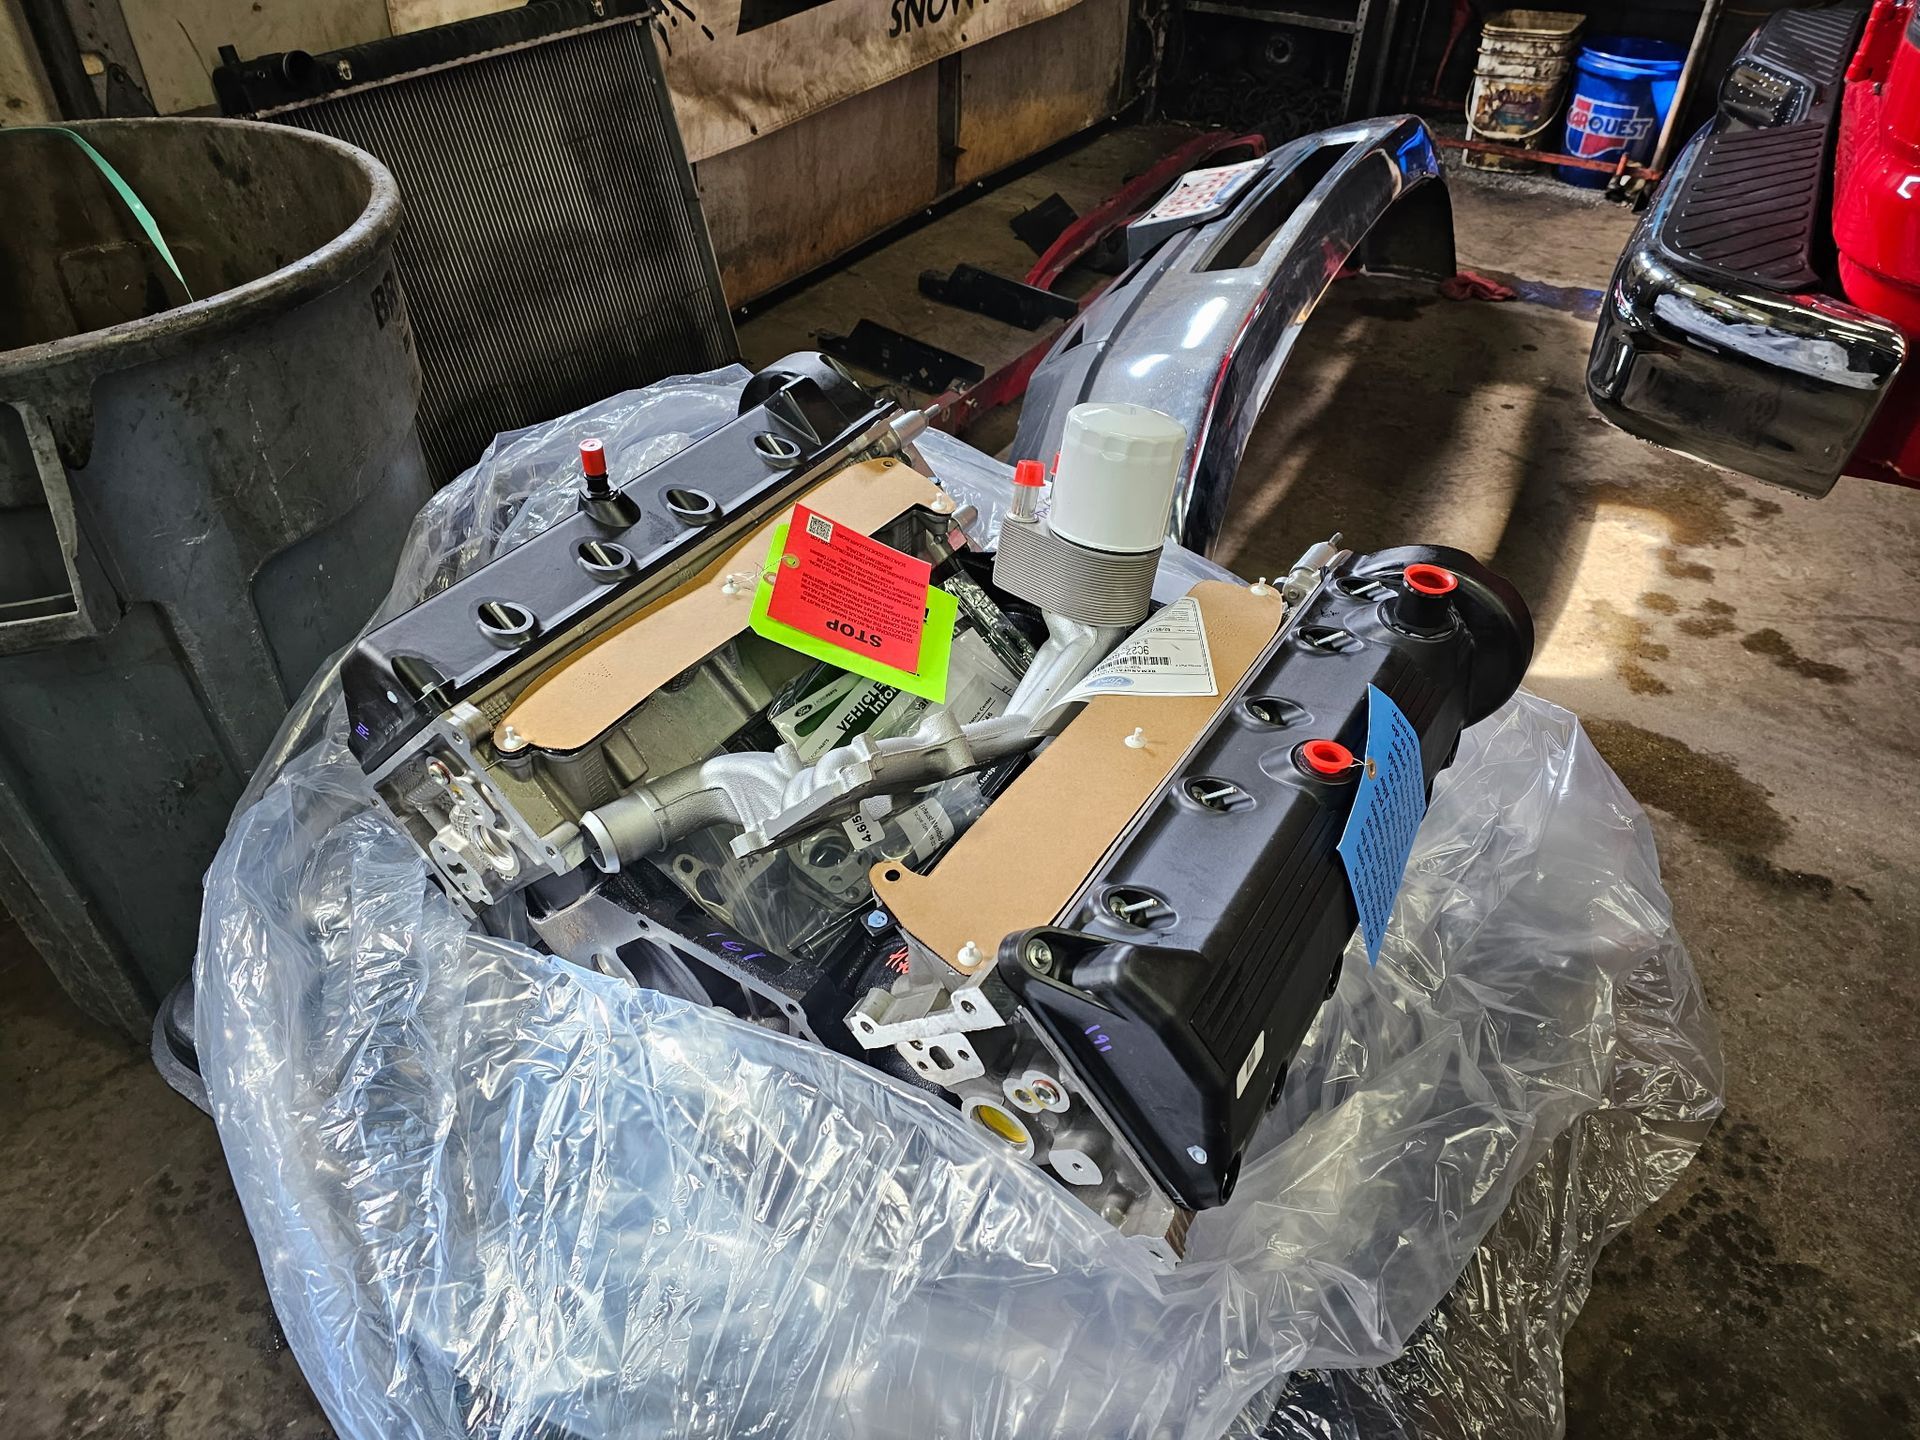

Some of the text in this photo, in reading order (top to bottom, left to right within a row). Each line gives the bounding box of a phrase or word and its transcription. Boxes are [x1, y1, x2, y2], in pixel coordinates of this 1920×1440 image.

[1567, 106, 1651, 138] CARQUEST
[823, 561, 836, 570] MUST
[825, 567, 840, 577] AFTER
[807, 581, 825, 592] RESULT
[857, 577, 880, 590] CHAMBER
[866, 576, 888, 588] CLEANED
[801, 583, 820, 595] FAILURE
[826, 589, 836, 597] WILL
[803, 591, 829, 605] SUSTAINED
[807, 598, 821, 608] MUST
[837, 595, 862, 608] MANIFOLD
[845, 593, 859, 602] FROM
[868, 596, 881, 605] VOIDS
[831, 603, 848, 614] ENGINE
[843, 603, 867, 616] CHAMBER
[860, 599, 882, 610] FAILURES
[863, 606, 880, 615] INTAKE
[821, 605, 847, 619] MANIFOLD
[849, 611, 872, 623] PREVIOUS
[883, 608, 900, 617] ENGINE
[847, 617, 864, 626] INTAKE
[867, 613, 899, 628] COMBUSTION
[891, 617, 911, 627] REPLACE
[826, 620, 881, 647] STOP
[978, 696, 992, 712] Center
[1391, 723, 1400, 738] do
[1391, 709, 1417, 752] warranty.
[1390, 739, 1407, 771] proper
[1387, 751, 1402, 782] should
[1379, 775, 1390, 800] After
[1374, 784, 1384, 808] prior
[1365, 815, 1375, 840] must
[1356, 843, 1366, 870] same
[1356, 880, 1366, 907] MUST
